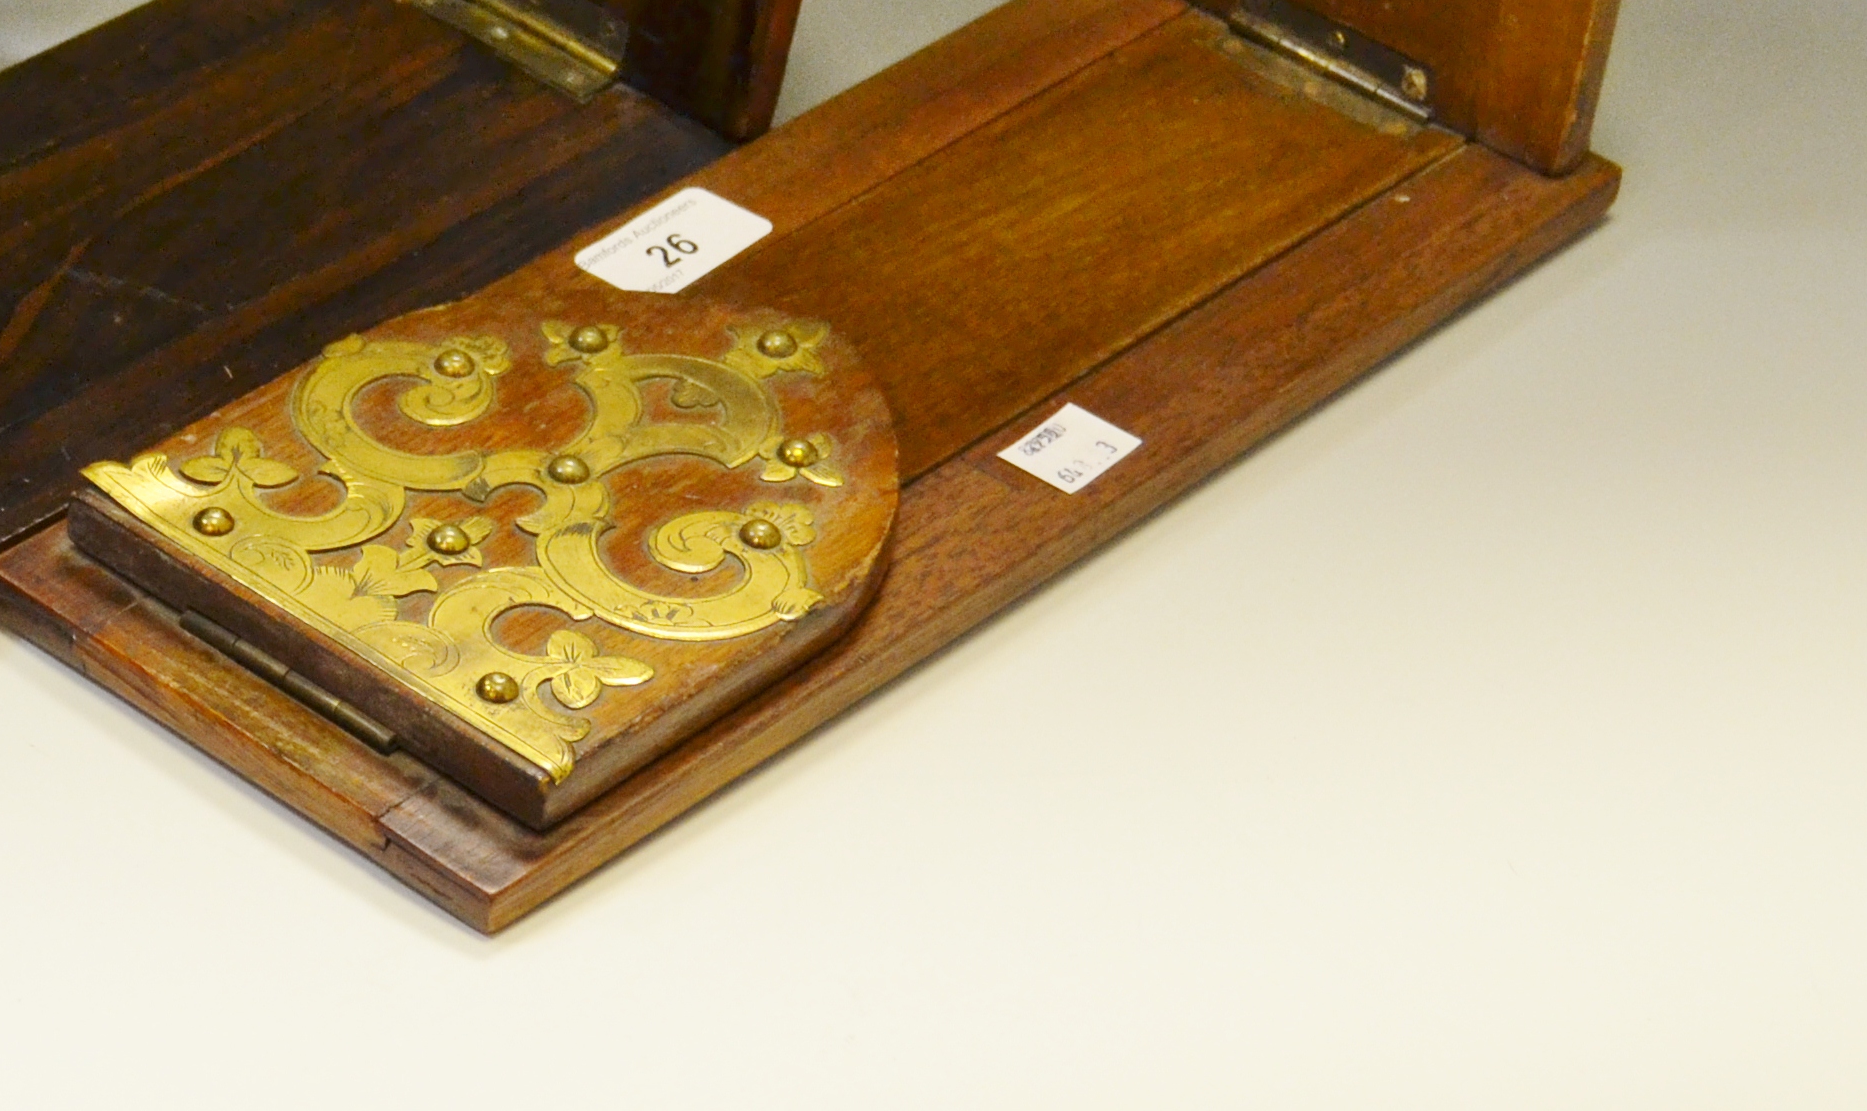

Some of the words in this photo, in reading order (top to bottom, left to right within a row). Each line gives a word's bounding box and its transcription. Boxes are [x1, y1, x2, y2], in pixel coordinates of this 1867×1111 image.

[578, 237, 632, 270] Bamfords
[632, 199, 697, 239] Auctioneers
[646, 233, 699, 268] 26
